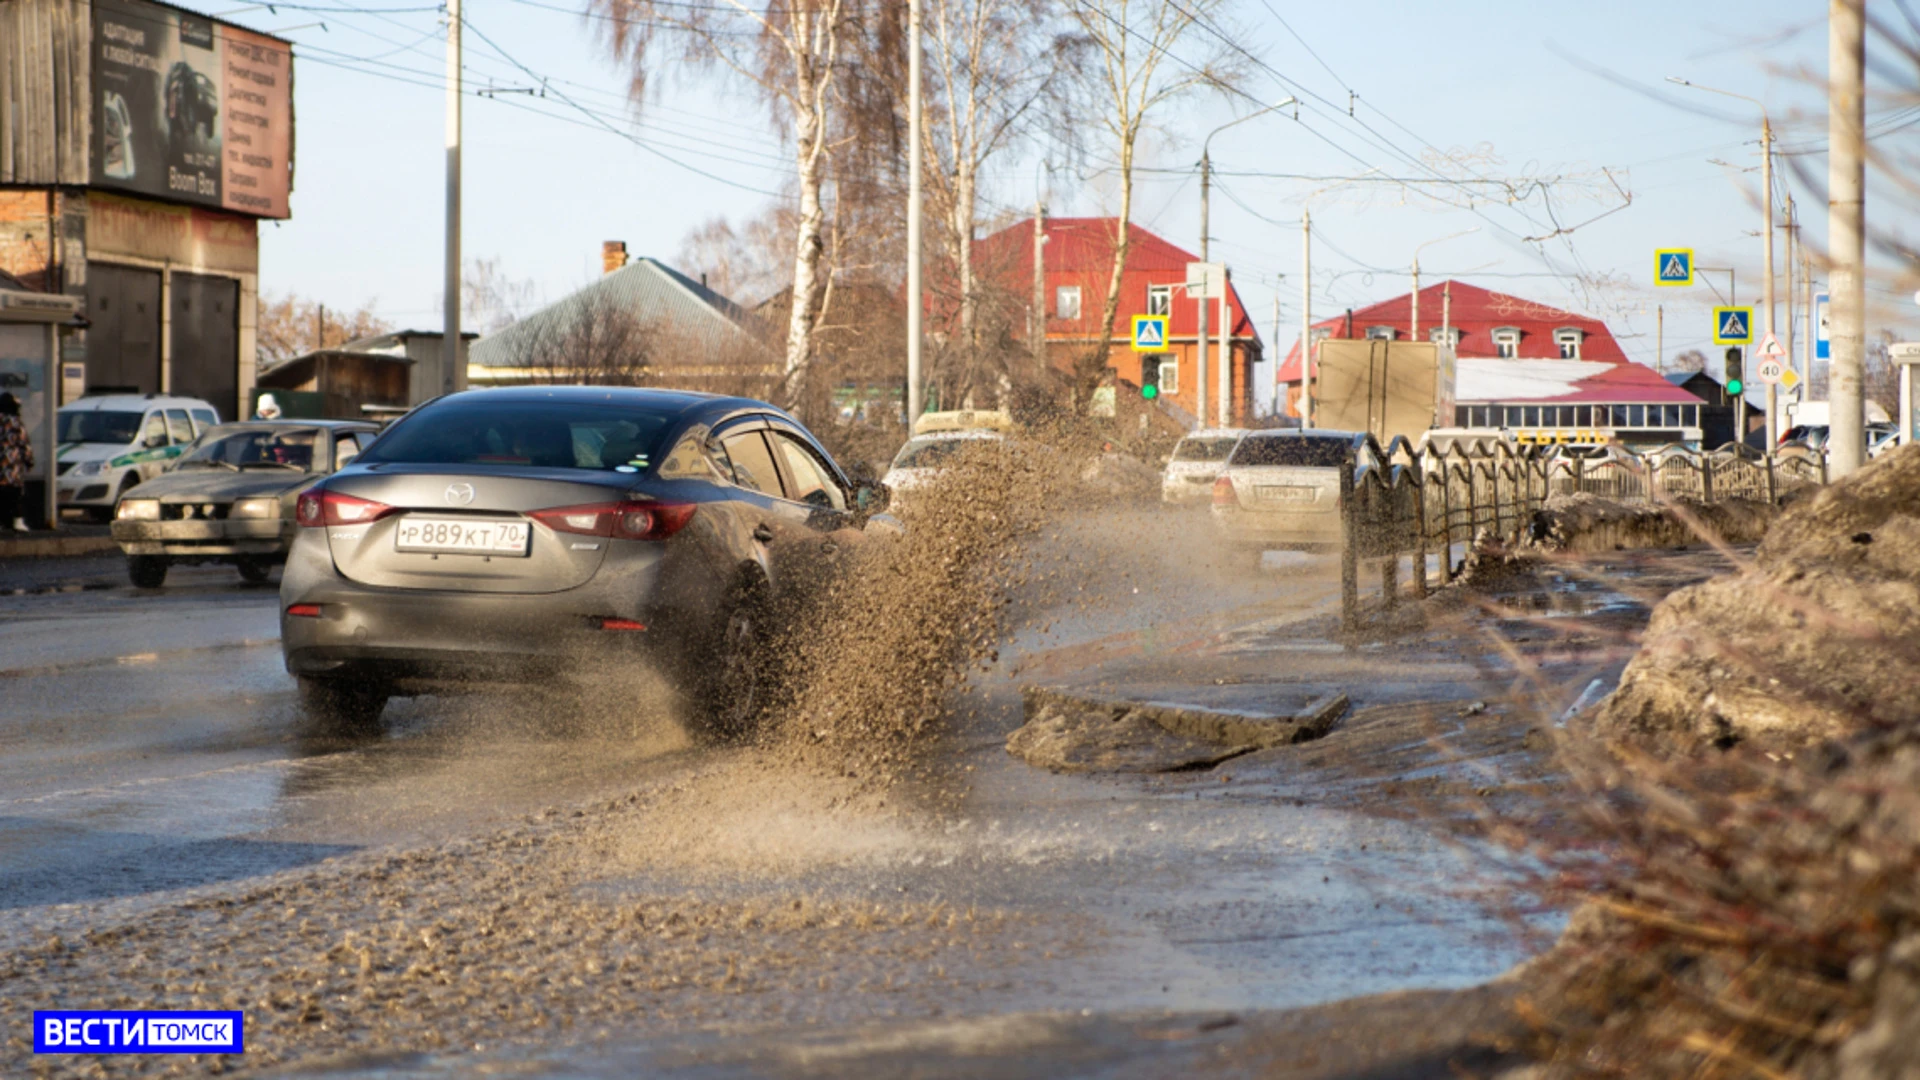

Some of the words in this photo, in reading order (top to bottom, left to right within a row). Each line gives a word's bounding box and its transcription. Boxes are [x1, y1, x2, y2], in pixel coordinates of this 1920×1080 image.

[169, 165, 197, 193] Boom
[198, 171, 216, 196] Box
[1762, 366, 1779, 376] 40
[1517, 430, 1609, 445] ЕБЕЛЬ
[499, 524, 519, 541] 70
